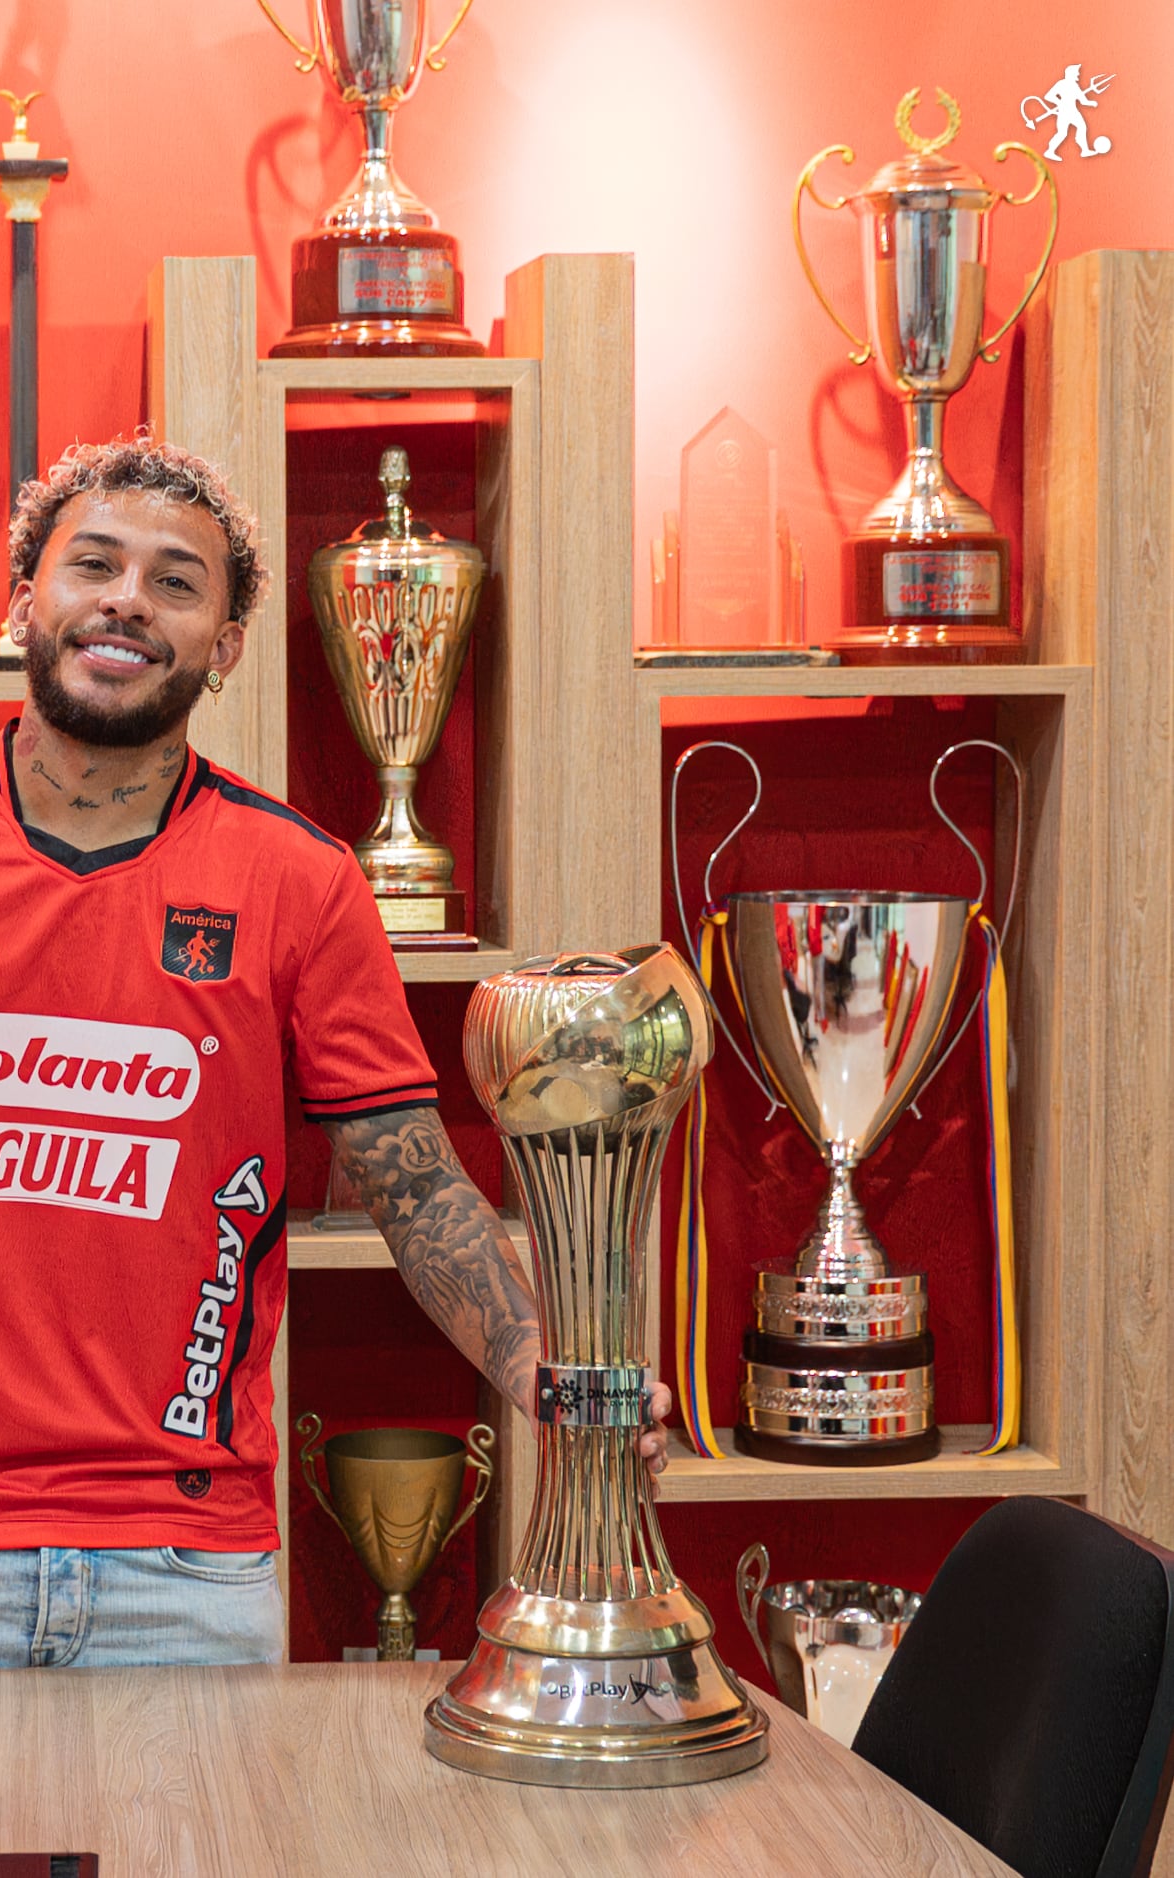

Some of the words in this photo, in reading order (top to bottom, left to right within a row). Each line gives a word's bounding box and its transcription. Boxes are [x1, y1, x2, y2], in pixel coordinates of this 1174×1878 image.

[354, 289, 382, 299] SUB
[170, 910, 232, 931] América
[162, 1212, 245, 1440] BetPlay
[587, 1388, 640, 1399] DIMAYOR
[559, 1680, 629, 1700] BtPlay
